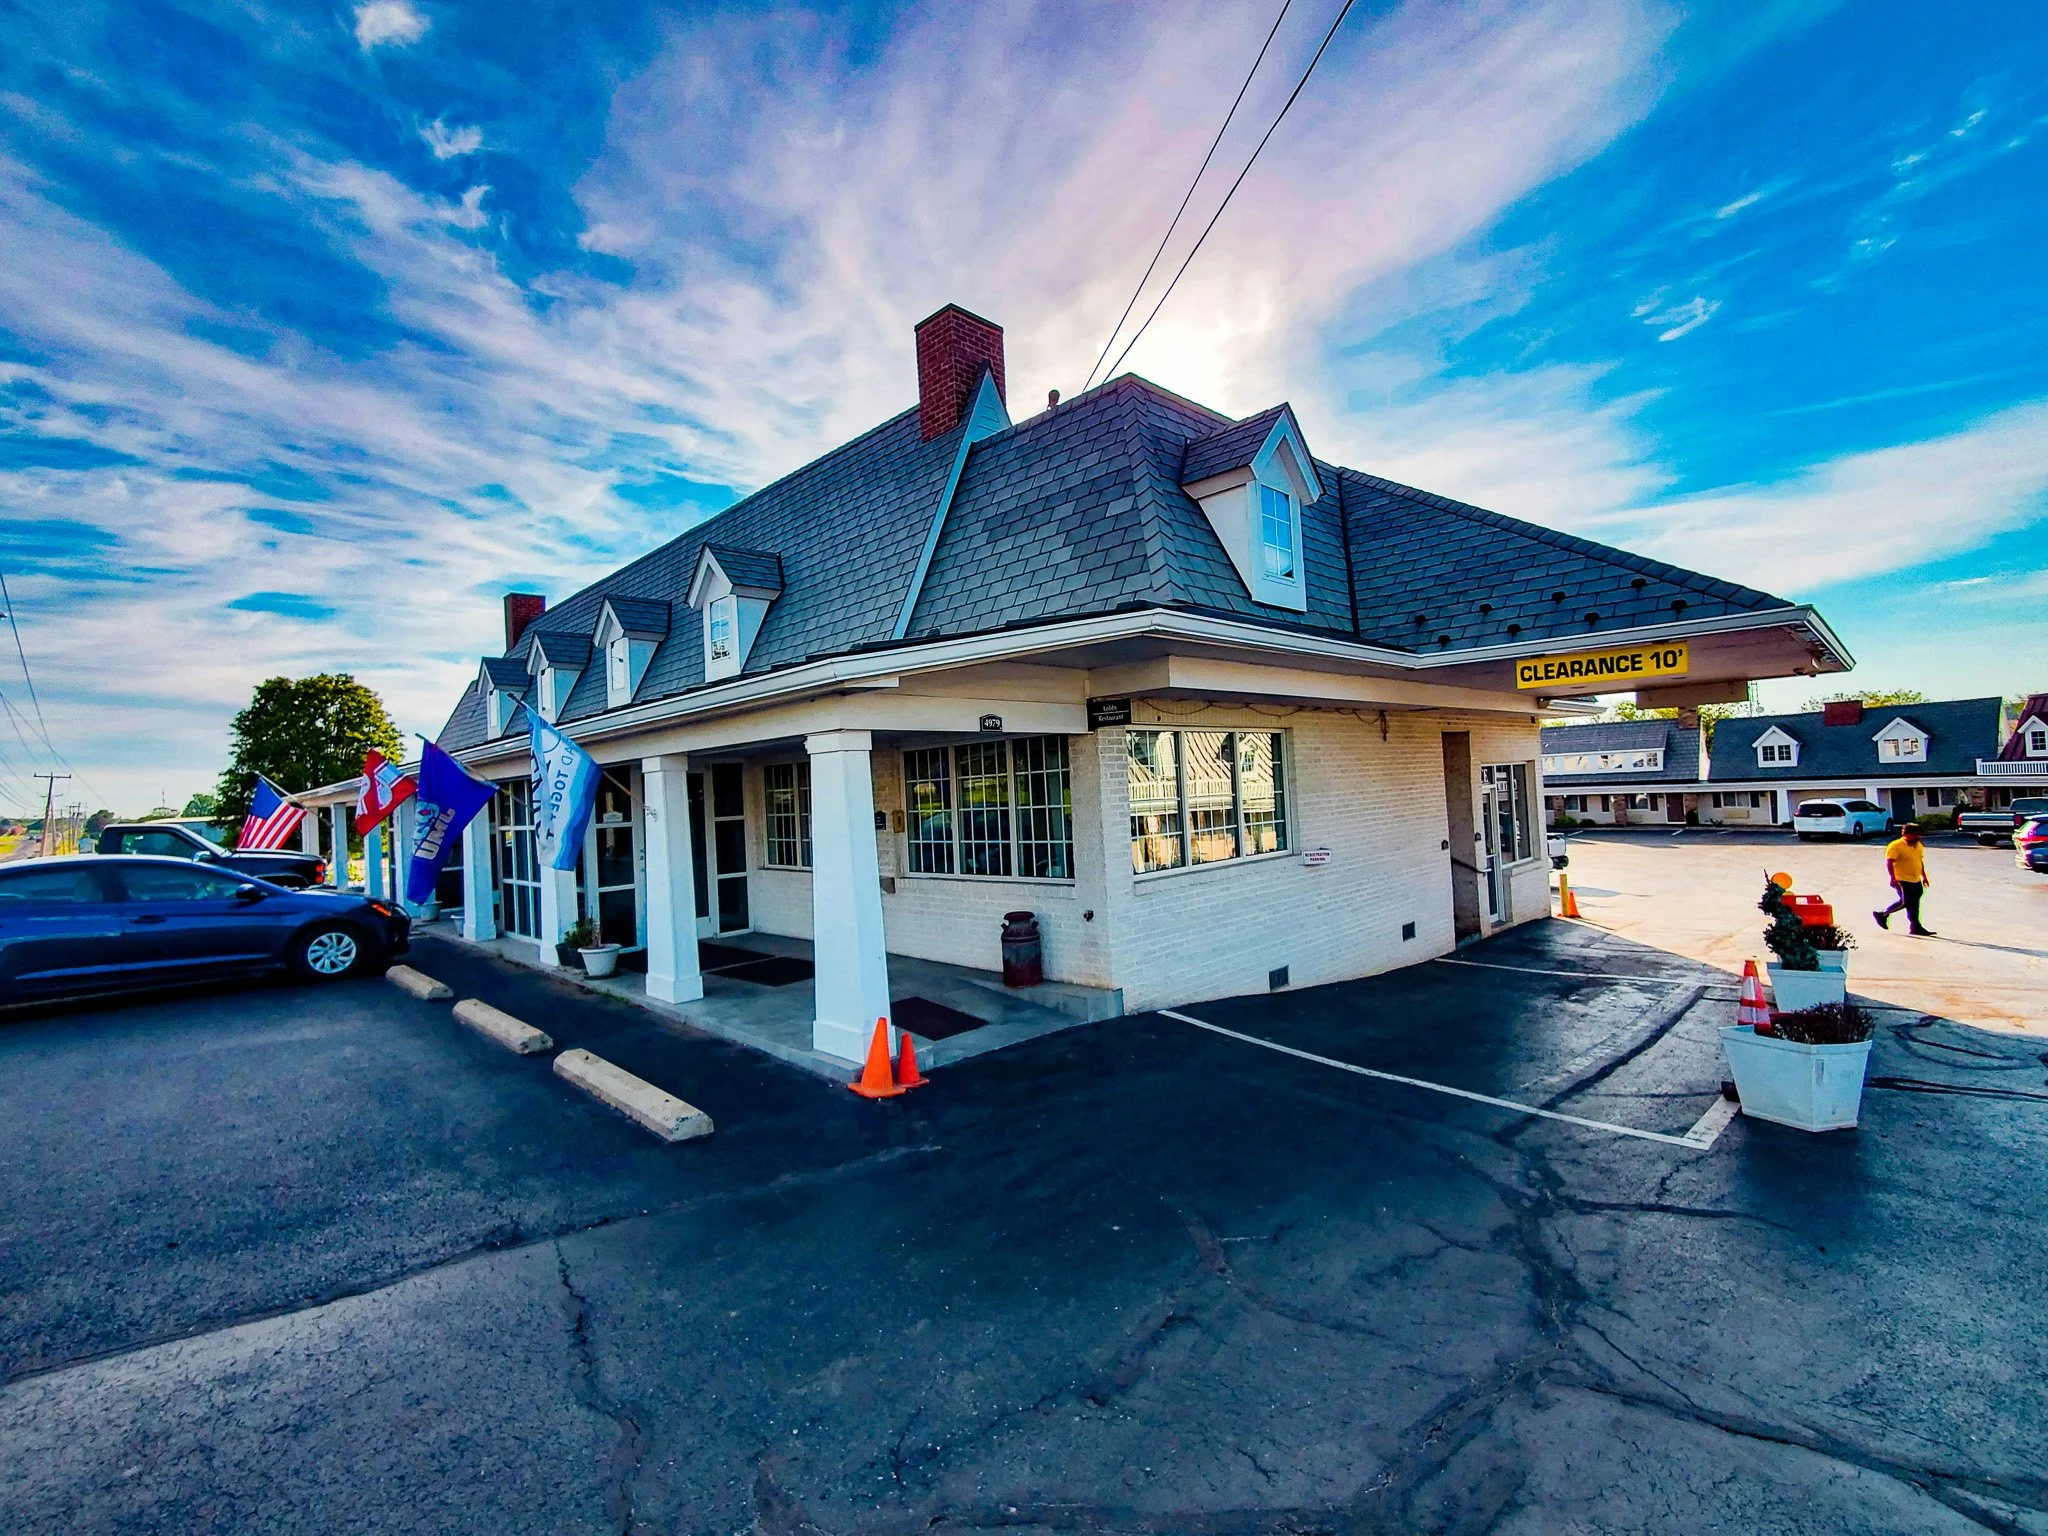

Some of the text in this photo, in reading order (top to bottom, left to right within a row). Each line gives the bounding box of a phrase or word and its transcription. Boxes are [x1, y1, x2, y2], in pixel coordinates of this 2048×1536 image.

[1519, 648, 1683, 682] CLEARANCE 10'
[1098, 713, 1124, 721] Restaurant
[984, 718, 1000, 728] 4979
